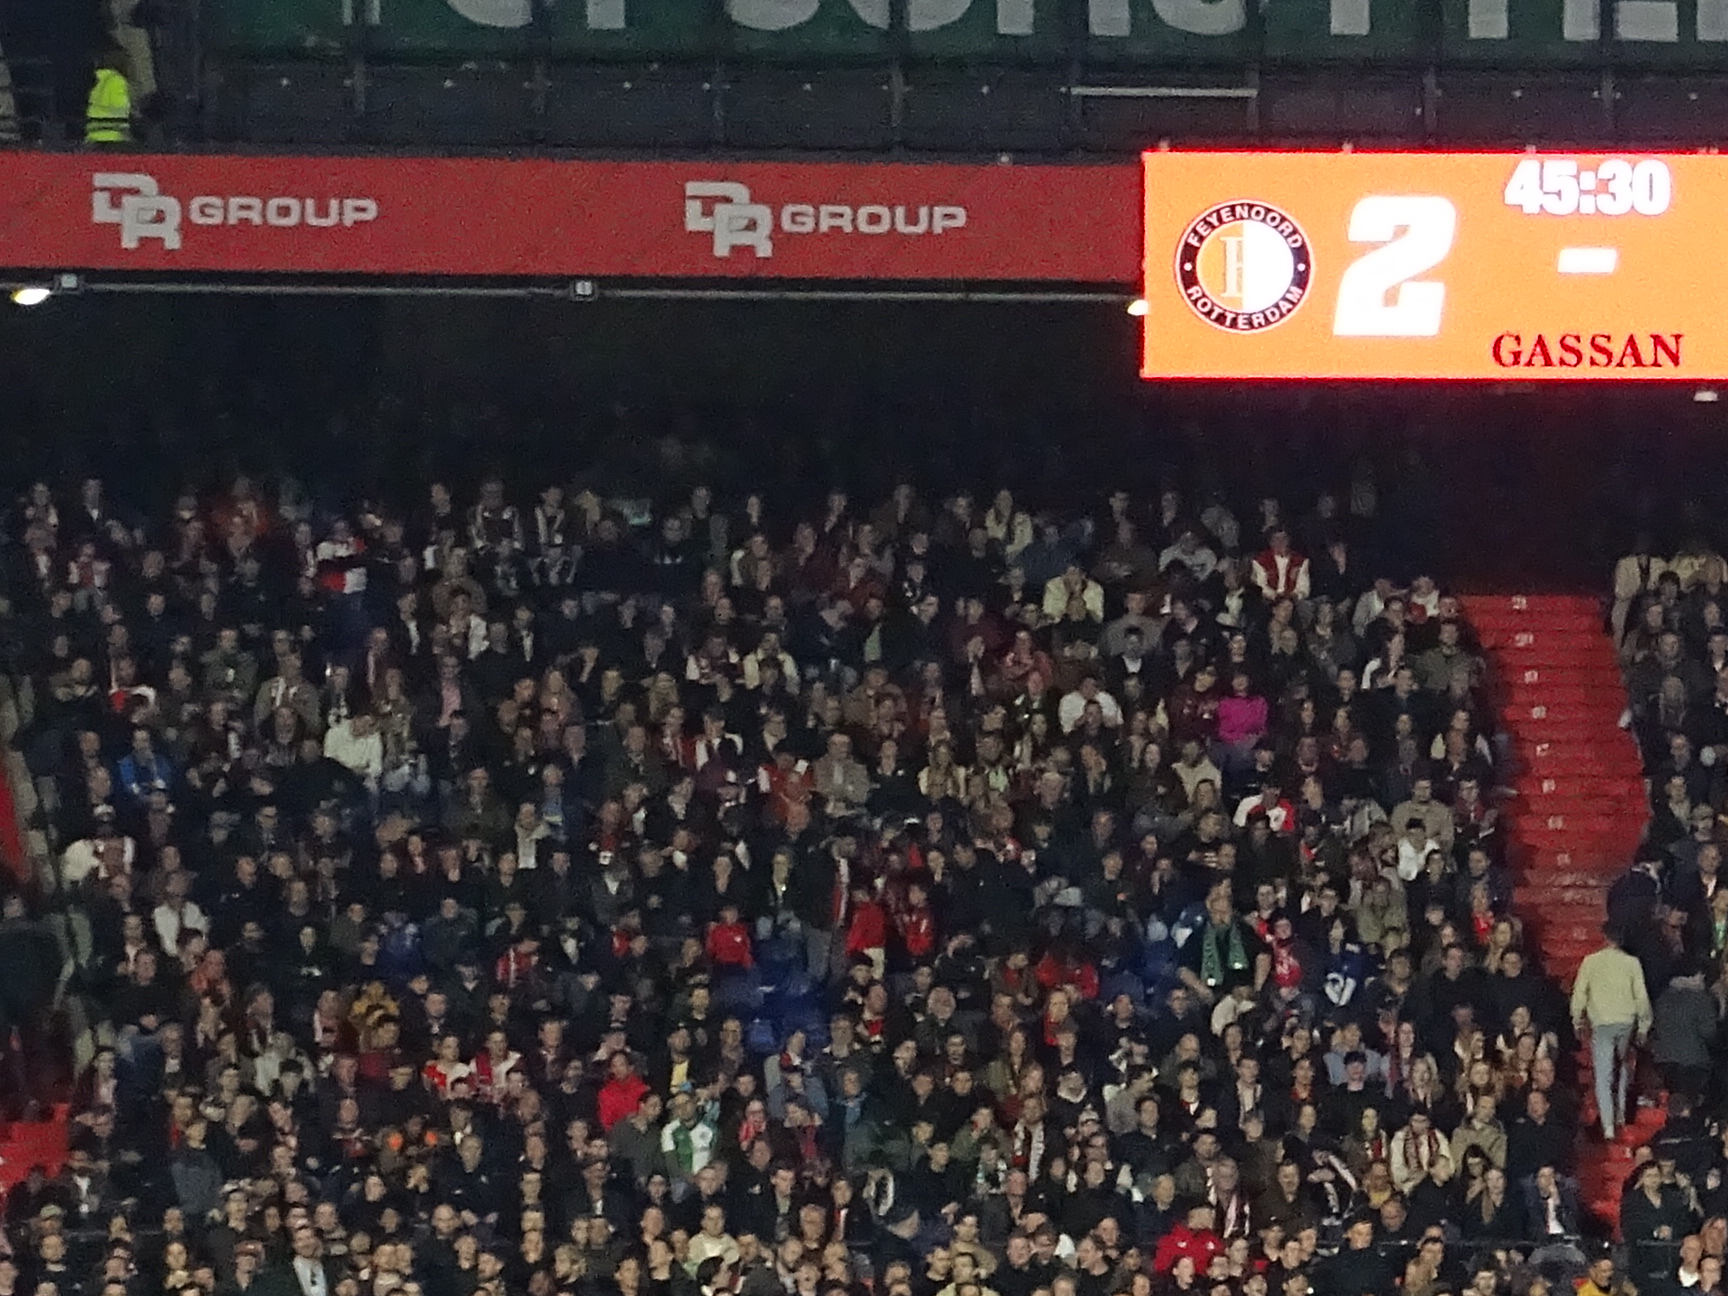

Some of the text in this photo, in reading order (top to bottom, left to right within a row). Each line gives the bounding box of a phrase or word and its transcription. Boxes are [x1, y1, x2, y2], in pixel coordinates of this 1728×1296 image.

[1504, 158, 1671, 216] 45:30
[189, 195, 379, 227] GROUP
[780, 204, 968, 235] GROUP
[1187, 205, 1303, 249] FEYENOORD
[1333, 196, 1457, 336] 2
[1187, 285, 1303, 330] ROTTERDAM
[1491, 333, 1685, 369] GASSAN
